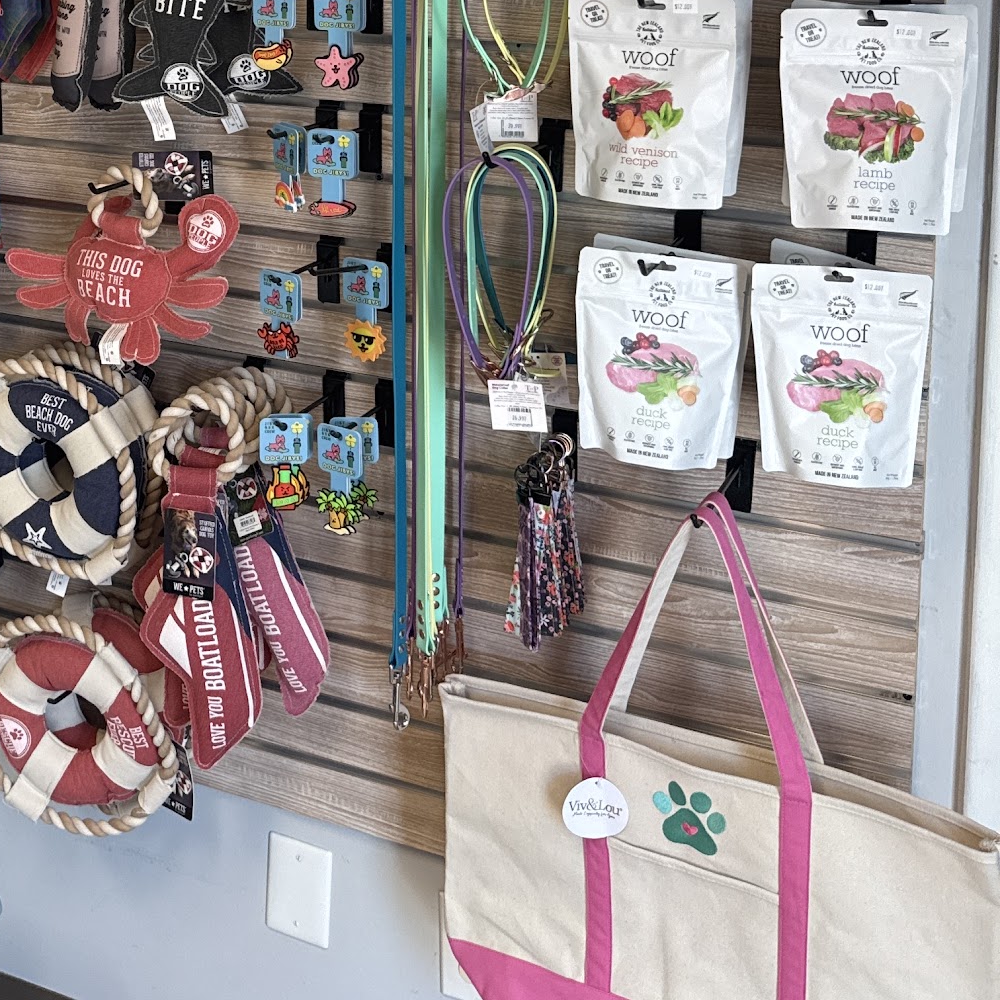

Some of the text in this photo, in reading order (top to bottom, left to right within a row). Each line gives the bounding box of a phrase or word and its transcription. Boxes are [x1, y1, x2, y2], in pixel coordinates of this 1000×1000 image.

[622, 48, 679, 67] woof
[840, 66, 901, 86] woof
[858, 166, 893, 178] lamb
[853, 179, 896, 192] recipe
[76, 249, 144, 278] THIS DOG
[82, 268, 124, 286] LOVES THE
[76, 278, 131, 308] BEACH
[632, 309, 690, 330] woof
[810, 324, 870, 343] woof
[41, 392, 68, 410] BEST
[25, 404, 74, 432] BEACH DOG
[636, 406, 668, 420] duck
[36, 421, 57, 437] EVER
[631, 417, 671, 431] recipe
[821, 425, 854, 438] duck
[817, 436, 859, 450] recipe
[173, 582, 204, 596] WE PETS
[239, 545, 307, 694] LOVE YOU BOATLOAD
[193, 599, 227, 750] LOVE YOU BOATLOAD
[129, 726, 149, 749] BEST
[568, 798, 620, 817] Viv&Lou
